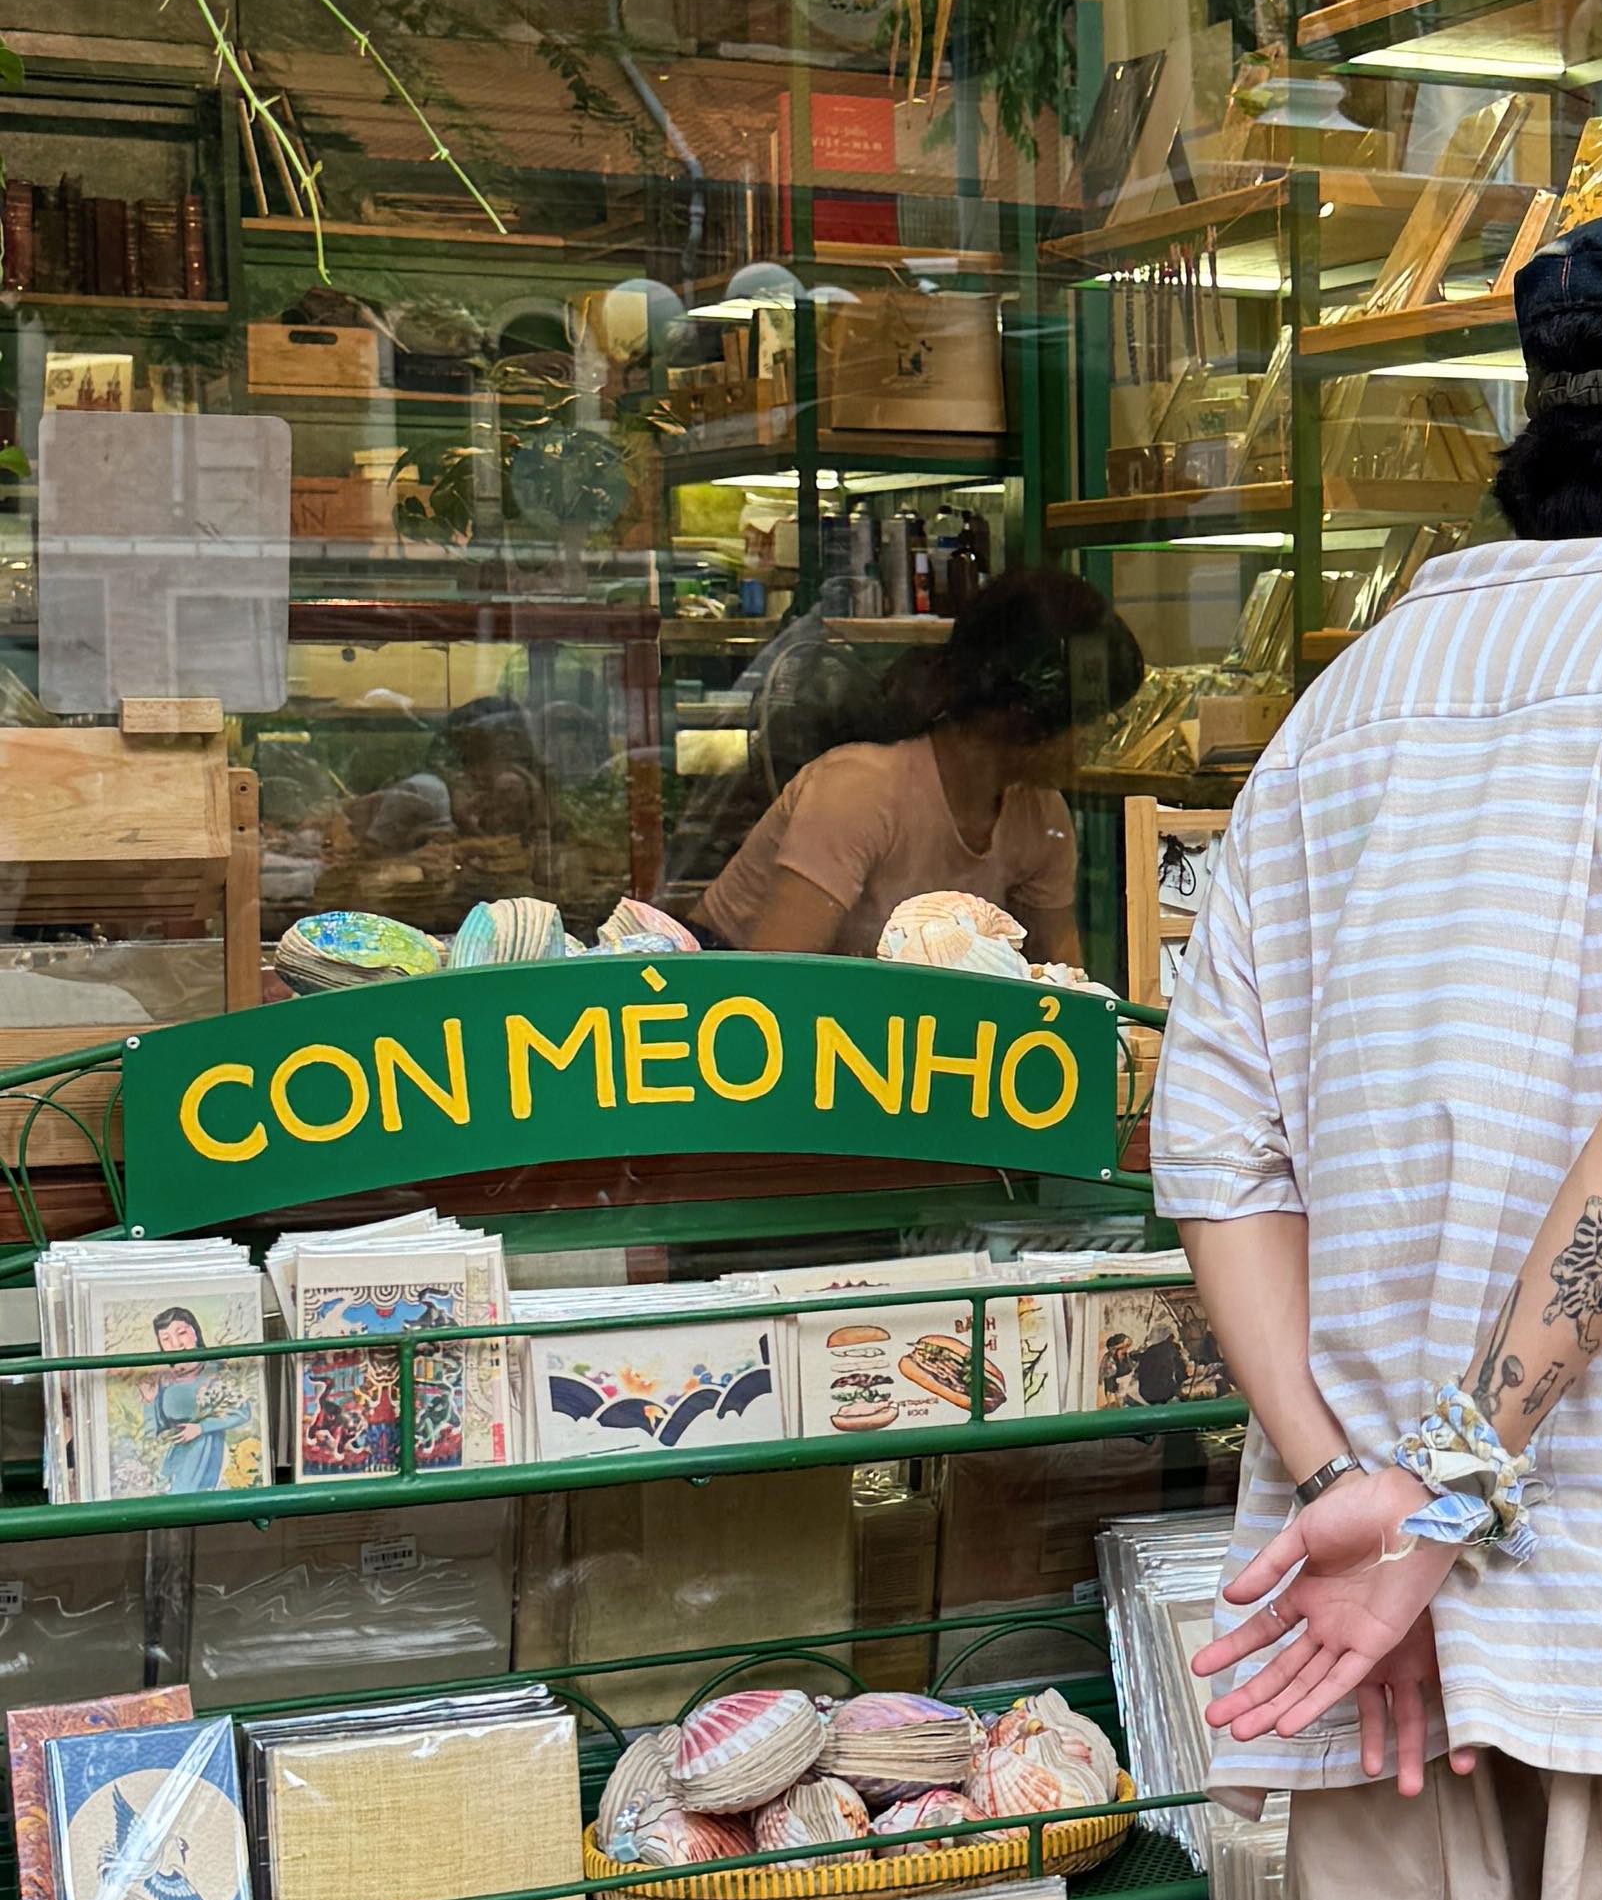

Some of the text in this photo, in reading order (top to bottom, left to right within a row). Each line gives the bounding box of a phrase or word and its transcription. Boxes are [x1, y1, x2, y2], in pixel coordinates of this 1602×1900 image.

[180, 964, 1081, 1163] CON MÈO NHỎ
[954, 1315, 997, 1334] BÁH
